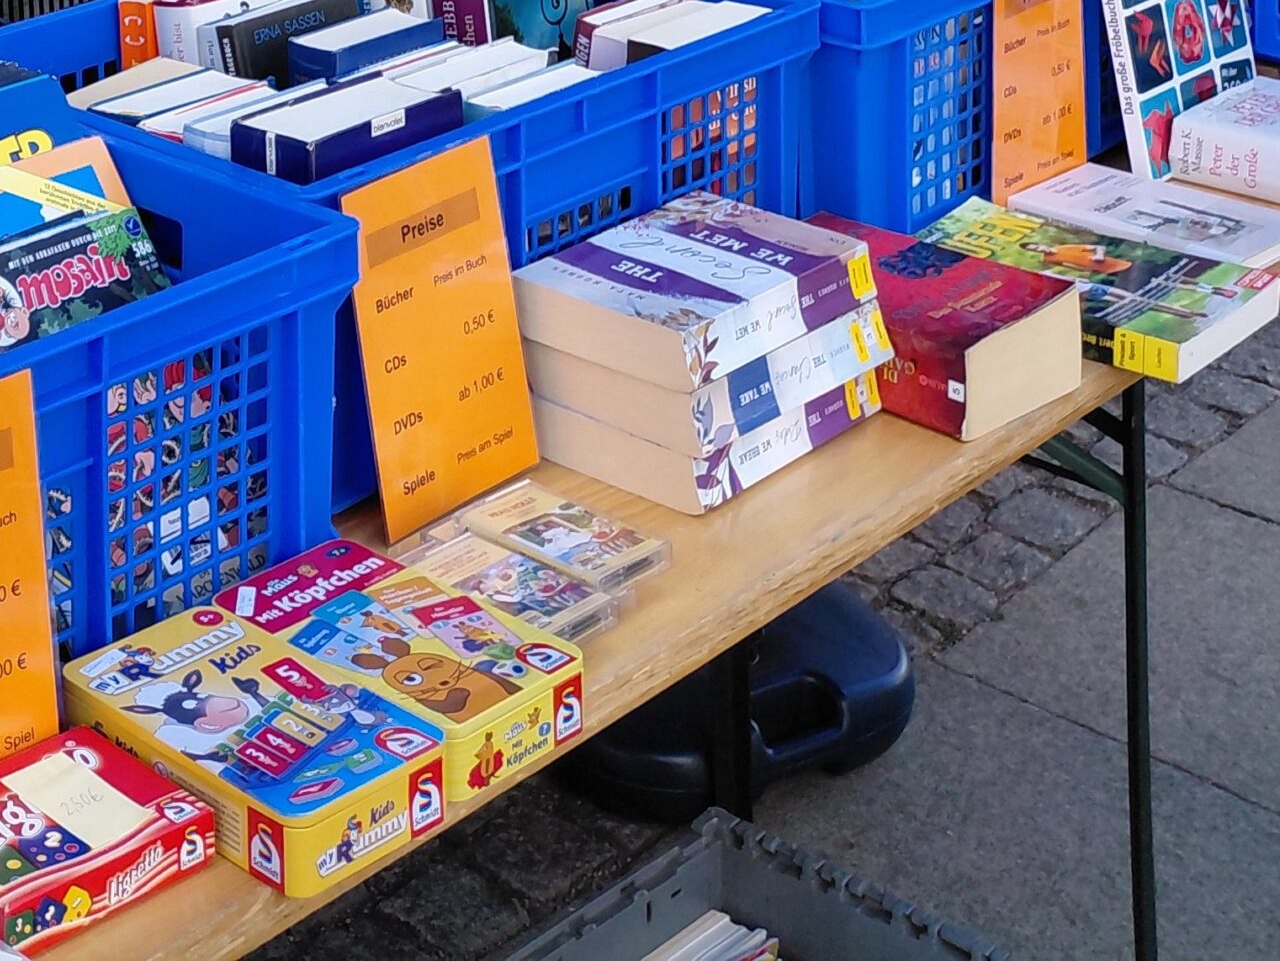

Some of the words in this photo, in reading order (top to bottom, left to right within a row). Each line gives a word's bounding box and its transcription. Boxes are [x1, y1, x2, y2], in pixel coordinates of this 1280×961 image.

[252, 24, 283, 46] ERNA
[283, 9, 326, 36] SASSEN
[1003, 36, 1027, 55] Bücher
[1116, 60, 1133, 94] große
[1003, 85, 1018, 100] CDs
[1123, 94, 1135, 116] Das
[373, 116, 404, 134] blanvalet
[1003, 128, 1022, 144] DVDs
[1179, 140, 1191, 176] Robert
[1191, 136, 1204, 175] Massie
[1208, 143, 1224, 178] Peter
[1225, 153, 1239, 177] der
[1003, 171, 1024, 189] Spiele
[1242, 147, 1260, 190] Große
[401, 212, 446, 245] Preise
[688, 229, 750, 252] MET
[131, 239, 153, 259] 586
[748, 244, 796, 267] WE
[432, 268, 455, 289] Preis
[464, 254, 488, 273] Buch
[610, 259, 665, 284] THE
[375, 286, 416, 315] Bücher
[462, 313, 487, 337] 0,50
[384, 354, 408, 375] CDs
[458, 385, 471, 403] ab
[472, 372, 495, 395] 1,00
[738, 388, 760, 408] TAKE
[393, 410, 425, 437] DVDs
[456, 445, 478, 466] Preis
[478, 441, 492, 455] am
[492, 427, 515, 447] Spiel
[402, 469, 437, 497] Spiele
[10, 579, 23, 597] €
[253, 604, 285, 627] Mit
[281, 554, 386, 616] Köpfchen
[259, 573, 299, 599] Maus
[16, 652, 29, 671] €
[207, 642, 262, 676] Kids
[3, 727, 37, 751] Spiel
[556, 718, 582, 740] Schmidt
[504, 735, 550, 770] Köpfchen
[510, 738, 524, 753] Mit
[367, 798, 396, 827] Kids
[413, 805, 441, 829] Schmidt
[105, 839, 165, 905] Ligretto
[251, 857, 281, 884] Schmidt
